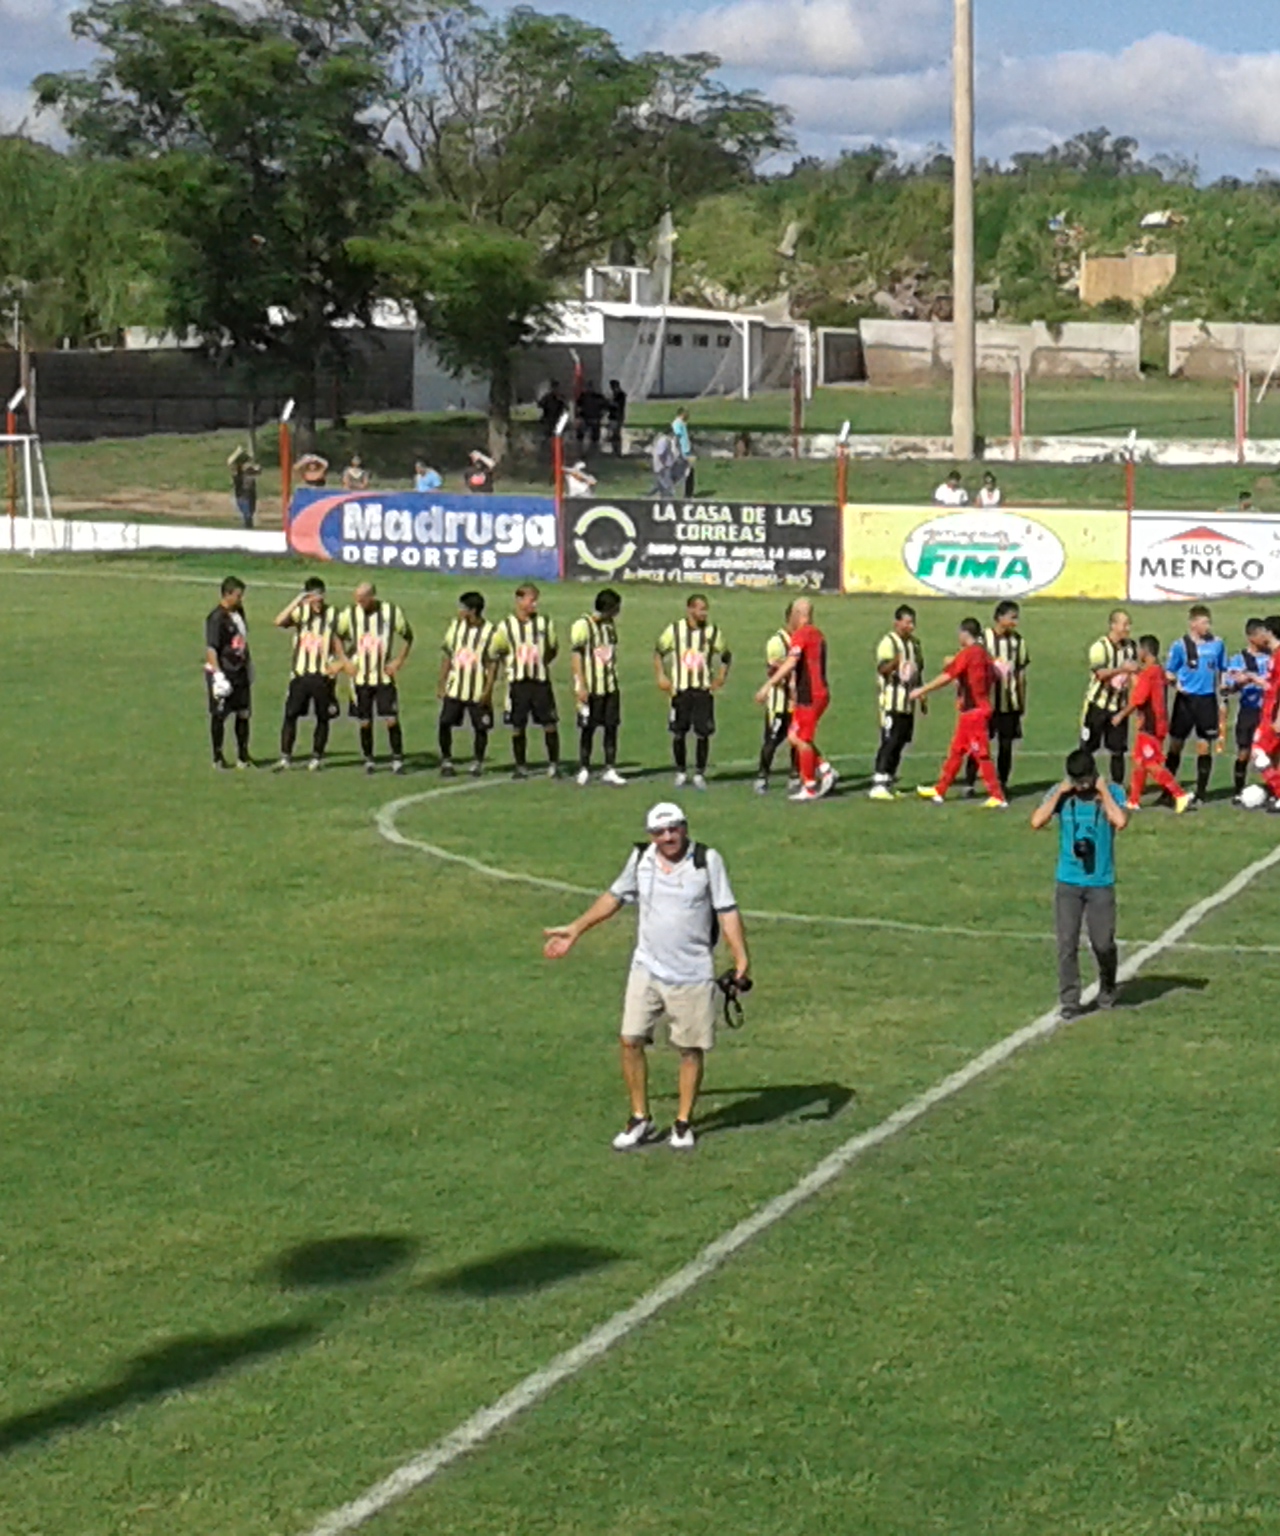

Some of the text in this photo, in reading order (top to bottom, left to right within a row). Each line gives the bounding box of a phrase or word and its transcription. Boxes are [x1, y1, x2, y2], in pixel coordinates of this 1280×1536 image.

[653, 503, 813, 526] LA CASA DE LAS
[342, 503, 557, 553] Madruga
[675, 524, 767, 543] CORREAS
[342, 546, 498, 568] DEPORTES
[916, 541, 1032, 581] FIMA
[1181, 544, 1223, 556] SILOS
[1140, 557, 1265, 580] MENGO
